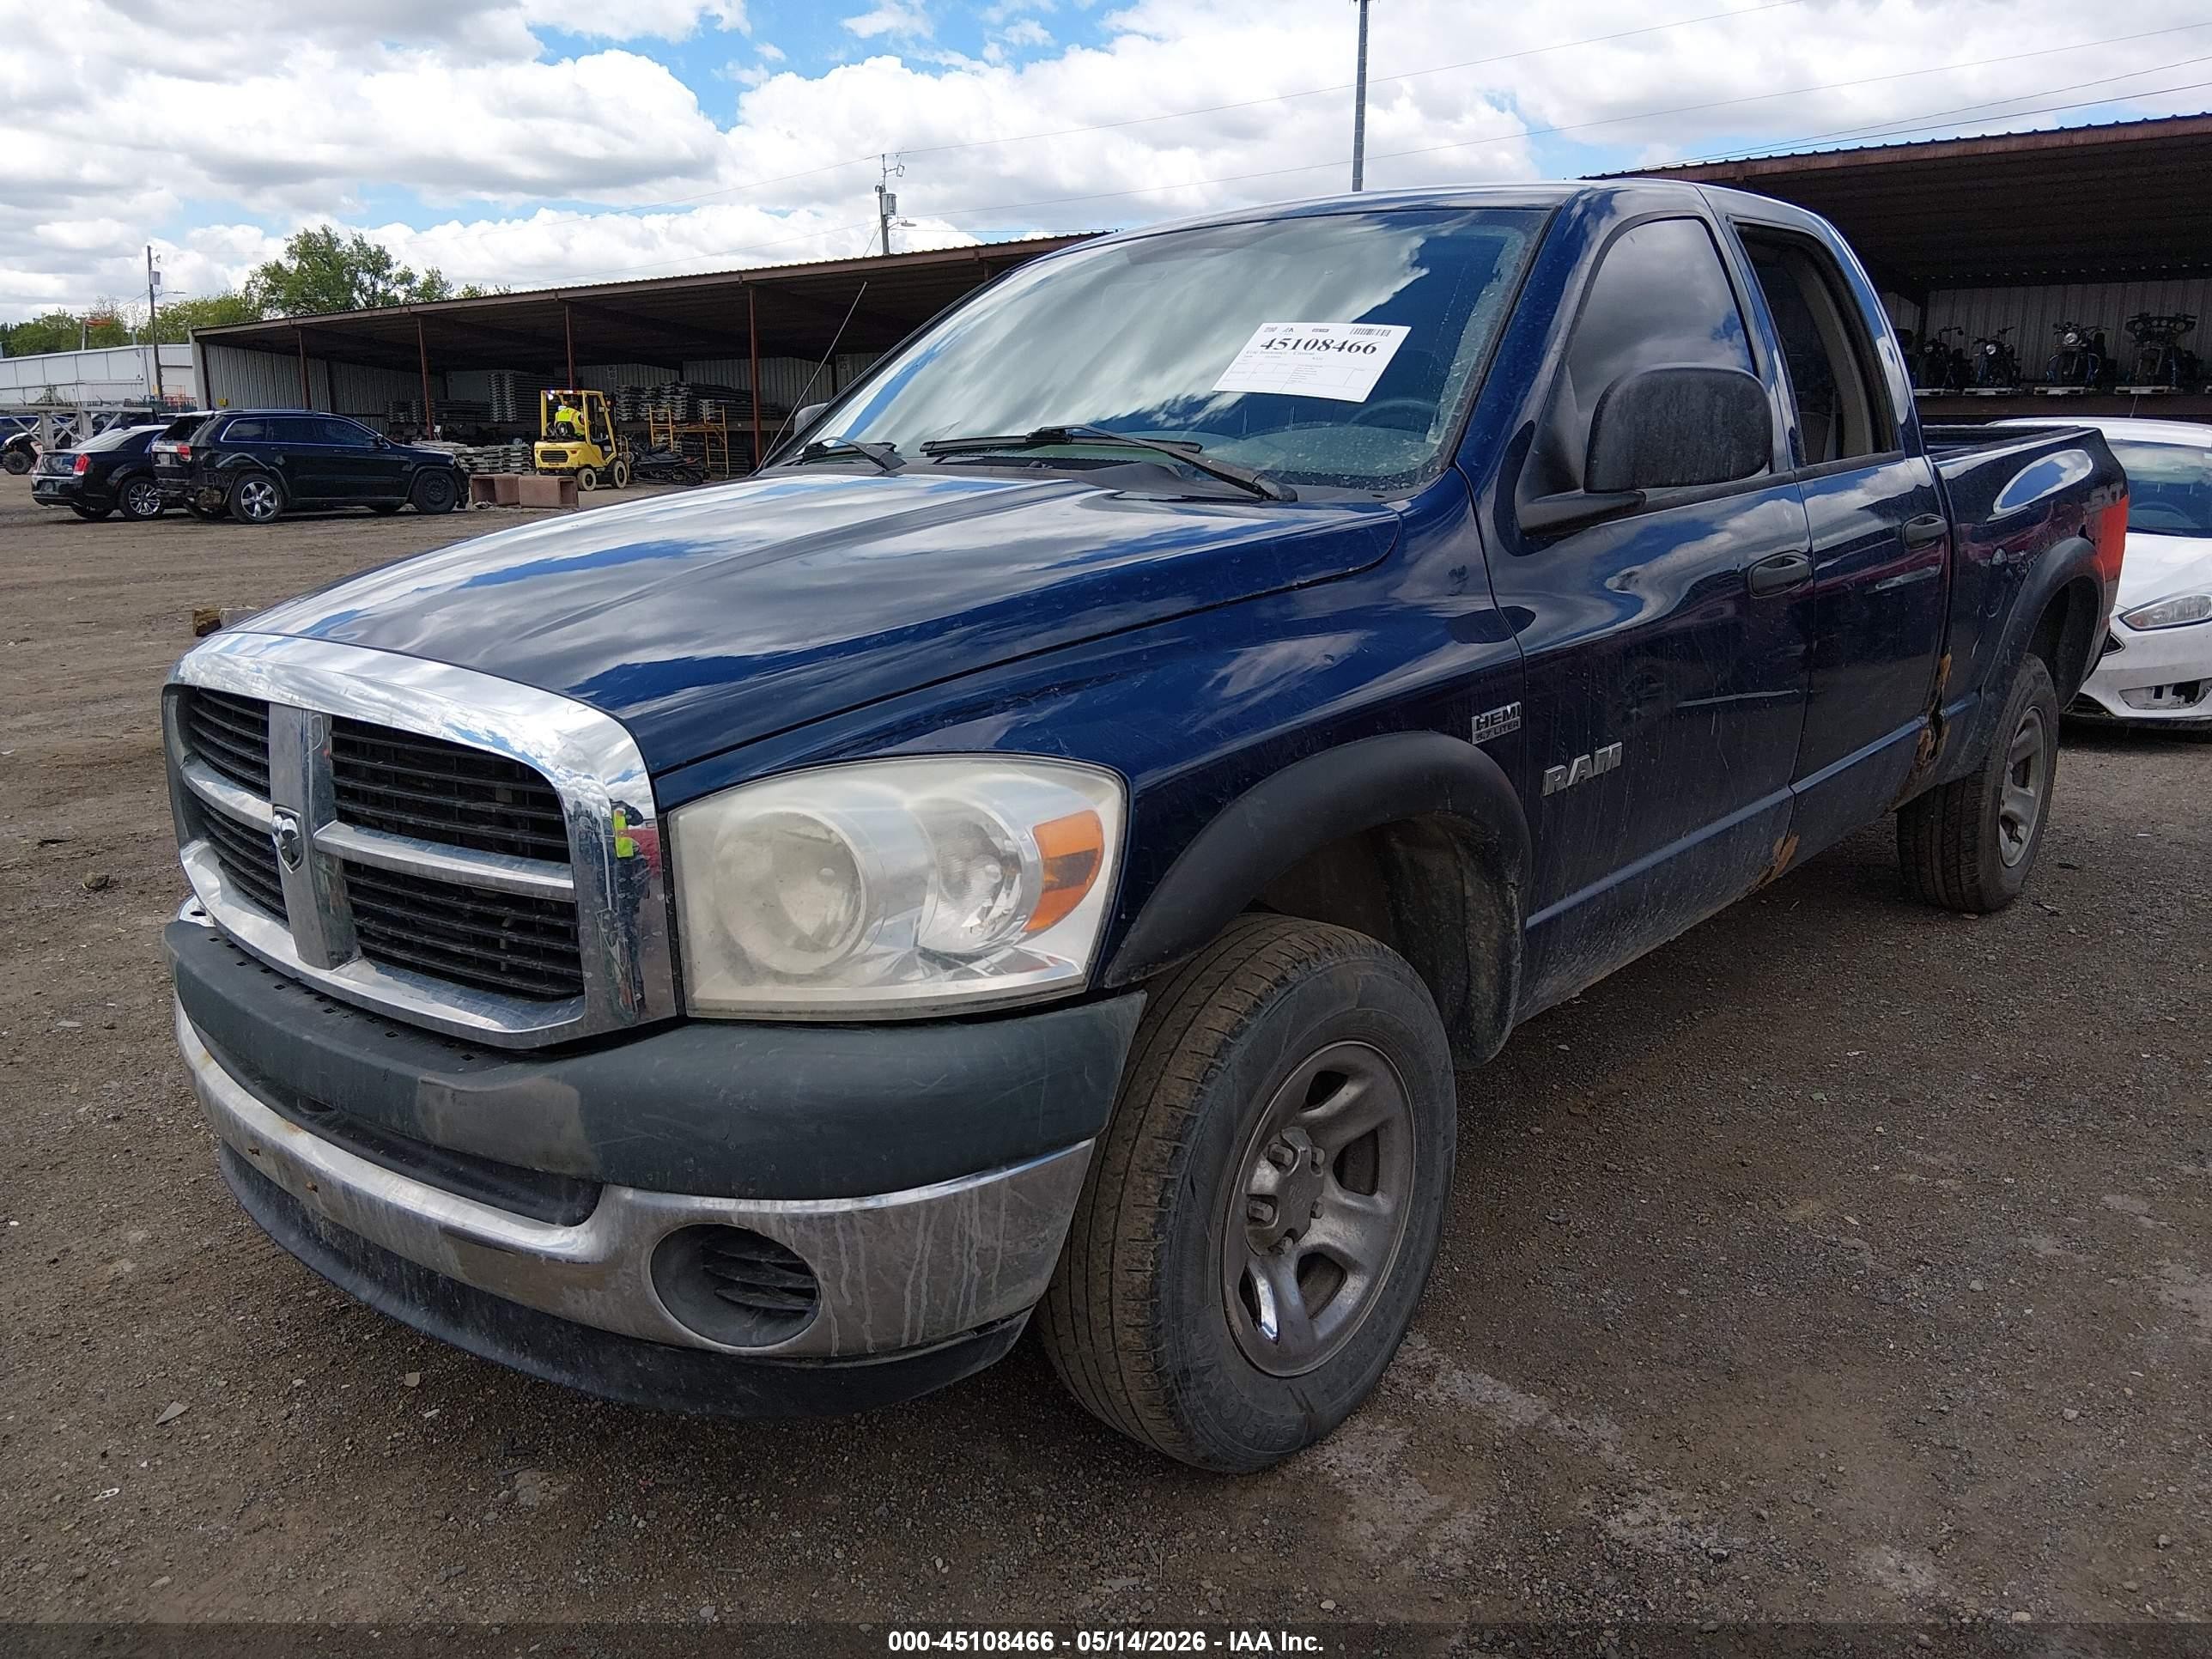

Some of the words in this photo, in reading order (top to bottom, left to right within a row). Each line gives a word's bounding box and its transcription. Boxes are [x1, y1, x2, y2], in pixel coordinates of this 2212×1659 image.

[1260, 337, 1382, 356] 45108466
[1471, 702, 1521, 732] HEMI
[1492, 719, 1520, 738] LITER
[1542, 742, 1622, 797] RAM
